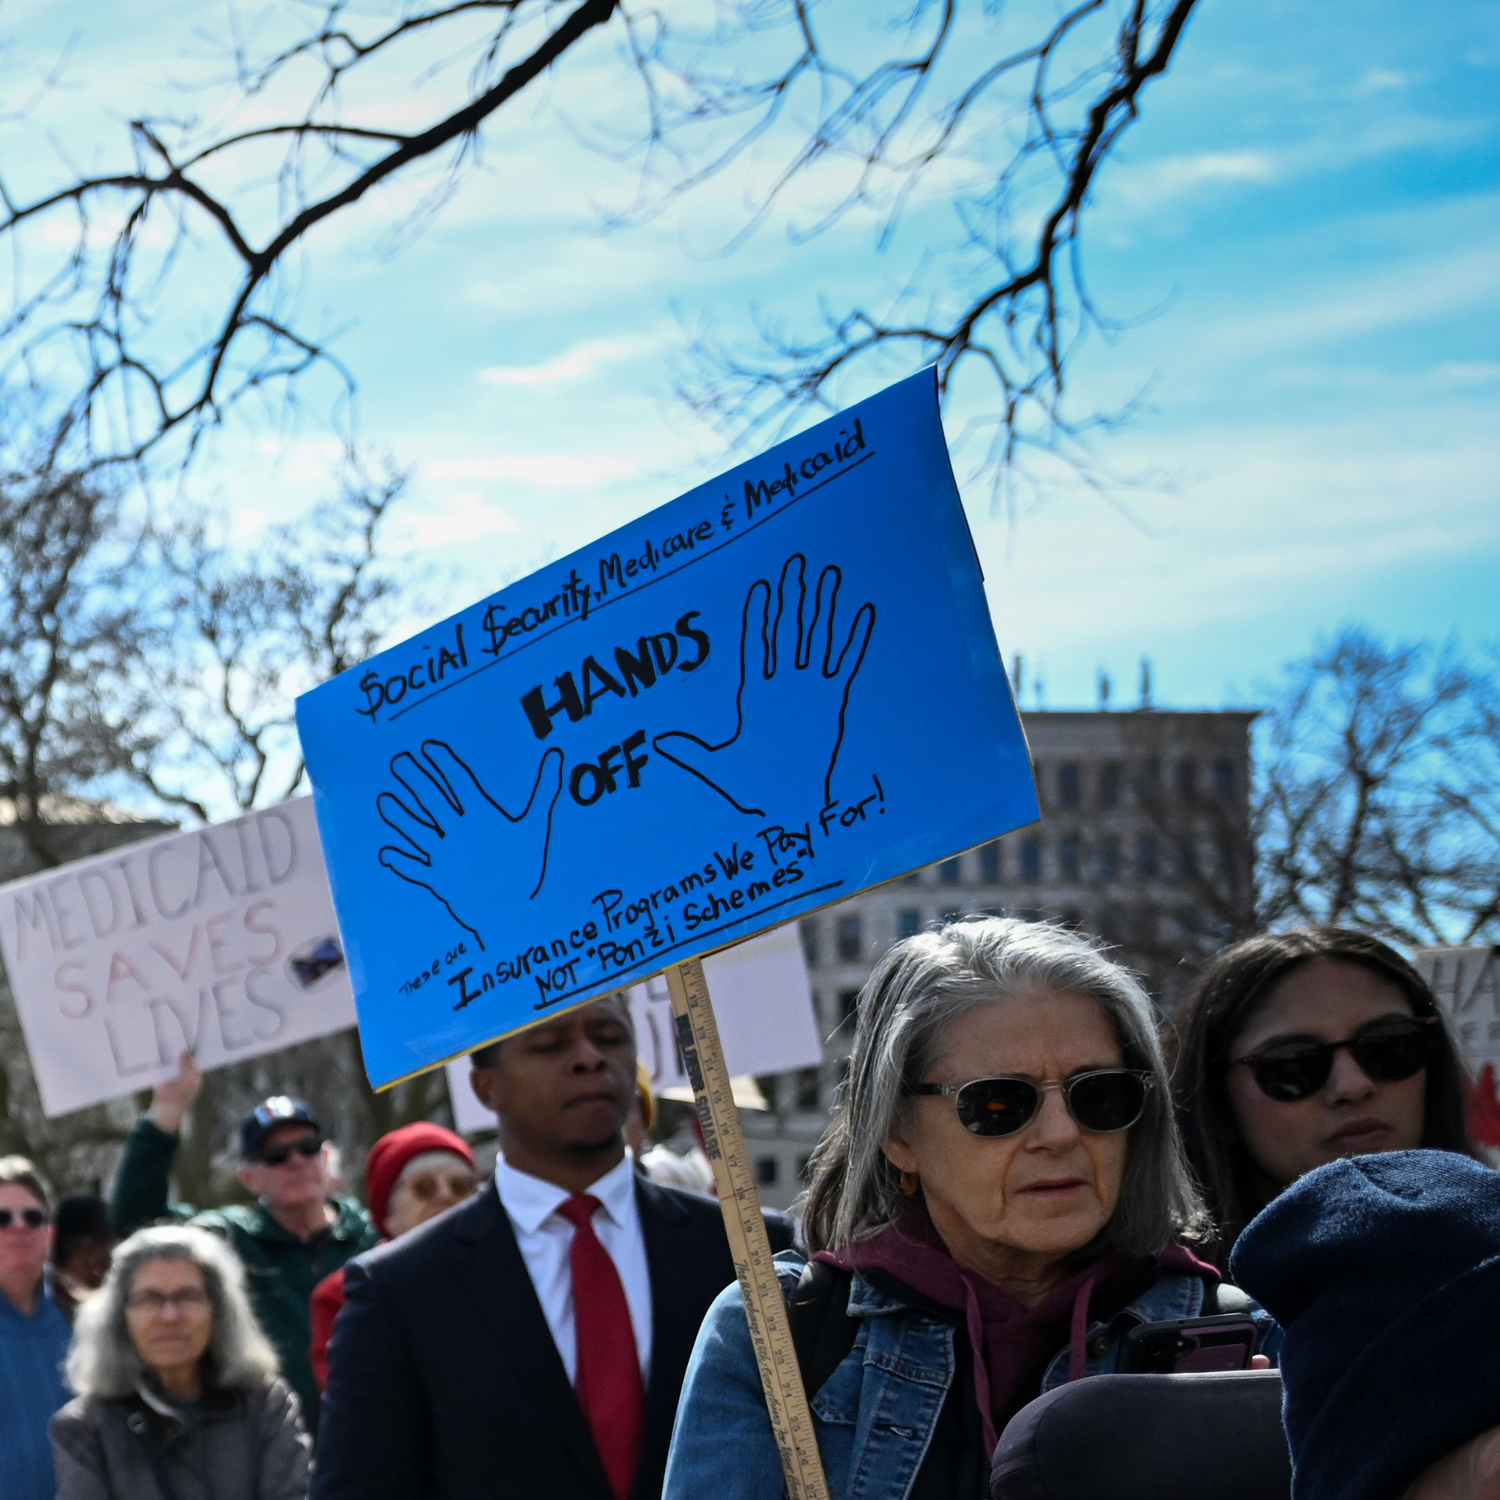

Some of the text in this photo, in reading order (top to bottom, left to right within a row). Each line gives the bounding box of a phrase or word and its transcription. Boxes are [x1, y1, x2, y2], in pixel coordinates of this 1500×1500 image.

[600, 521, 715, 595] Medicare
[721, 494, 735, 531] &
[744, 418, 866, 520] Medicaid
[520, 611, 710, 740] HANDS
[569, 730, 648, 806] OFF
[13, 812, 296, 961] MEDICAID
[448, 774, 885, 1010] Insurance Programs We Pay For!
[54, 900, 284, 1019] SAVES
[398, 942, 467, 996] These are
[534, 958, 580, 1005] NOT
[104, 968, 286, 1077] LIVES
[691, 1095, 725, 1161] SQUARE
[733, 1259, 751, 1280] The
[749, 1250, 761, 1266] 20
[757, 1283, 769, 1298] 21
[765, 1315, 777, 1332] 22
[773, 1348, 785, 1365] 23
[781, 1382, 793, 1398] 24
[789, 1415, 801, 1432] 25
[796, 1449, 808, 1465] 26
[805, 1483, 818, 1499] 27
